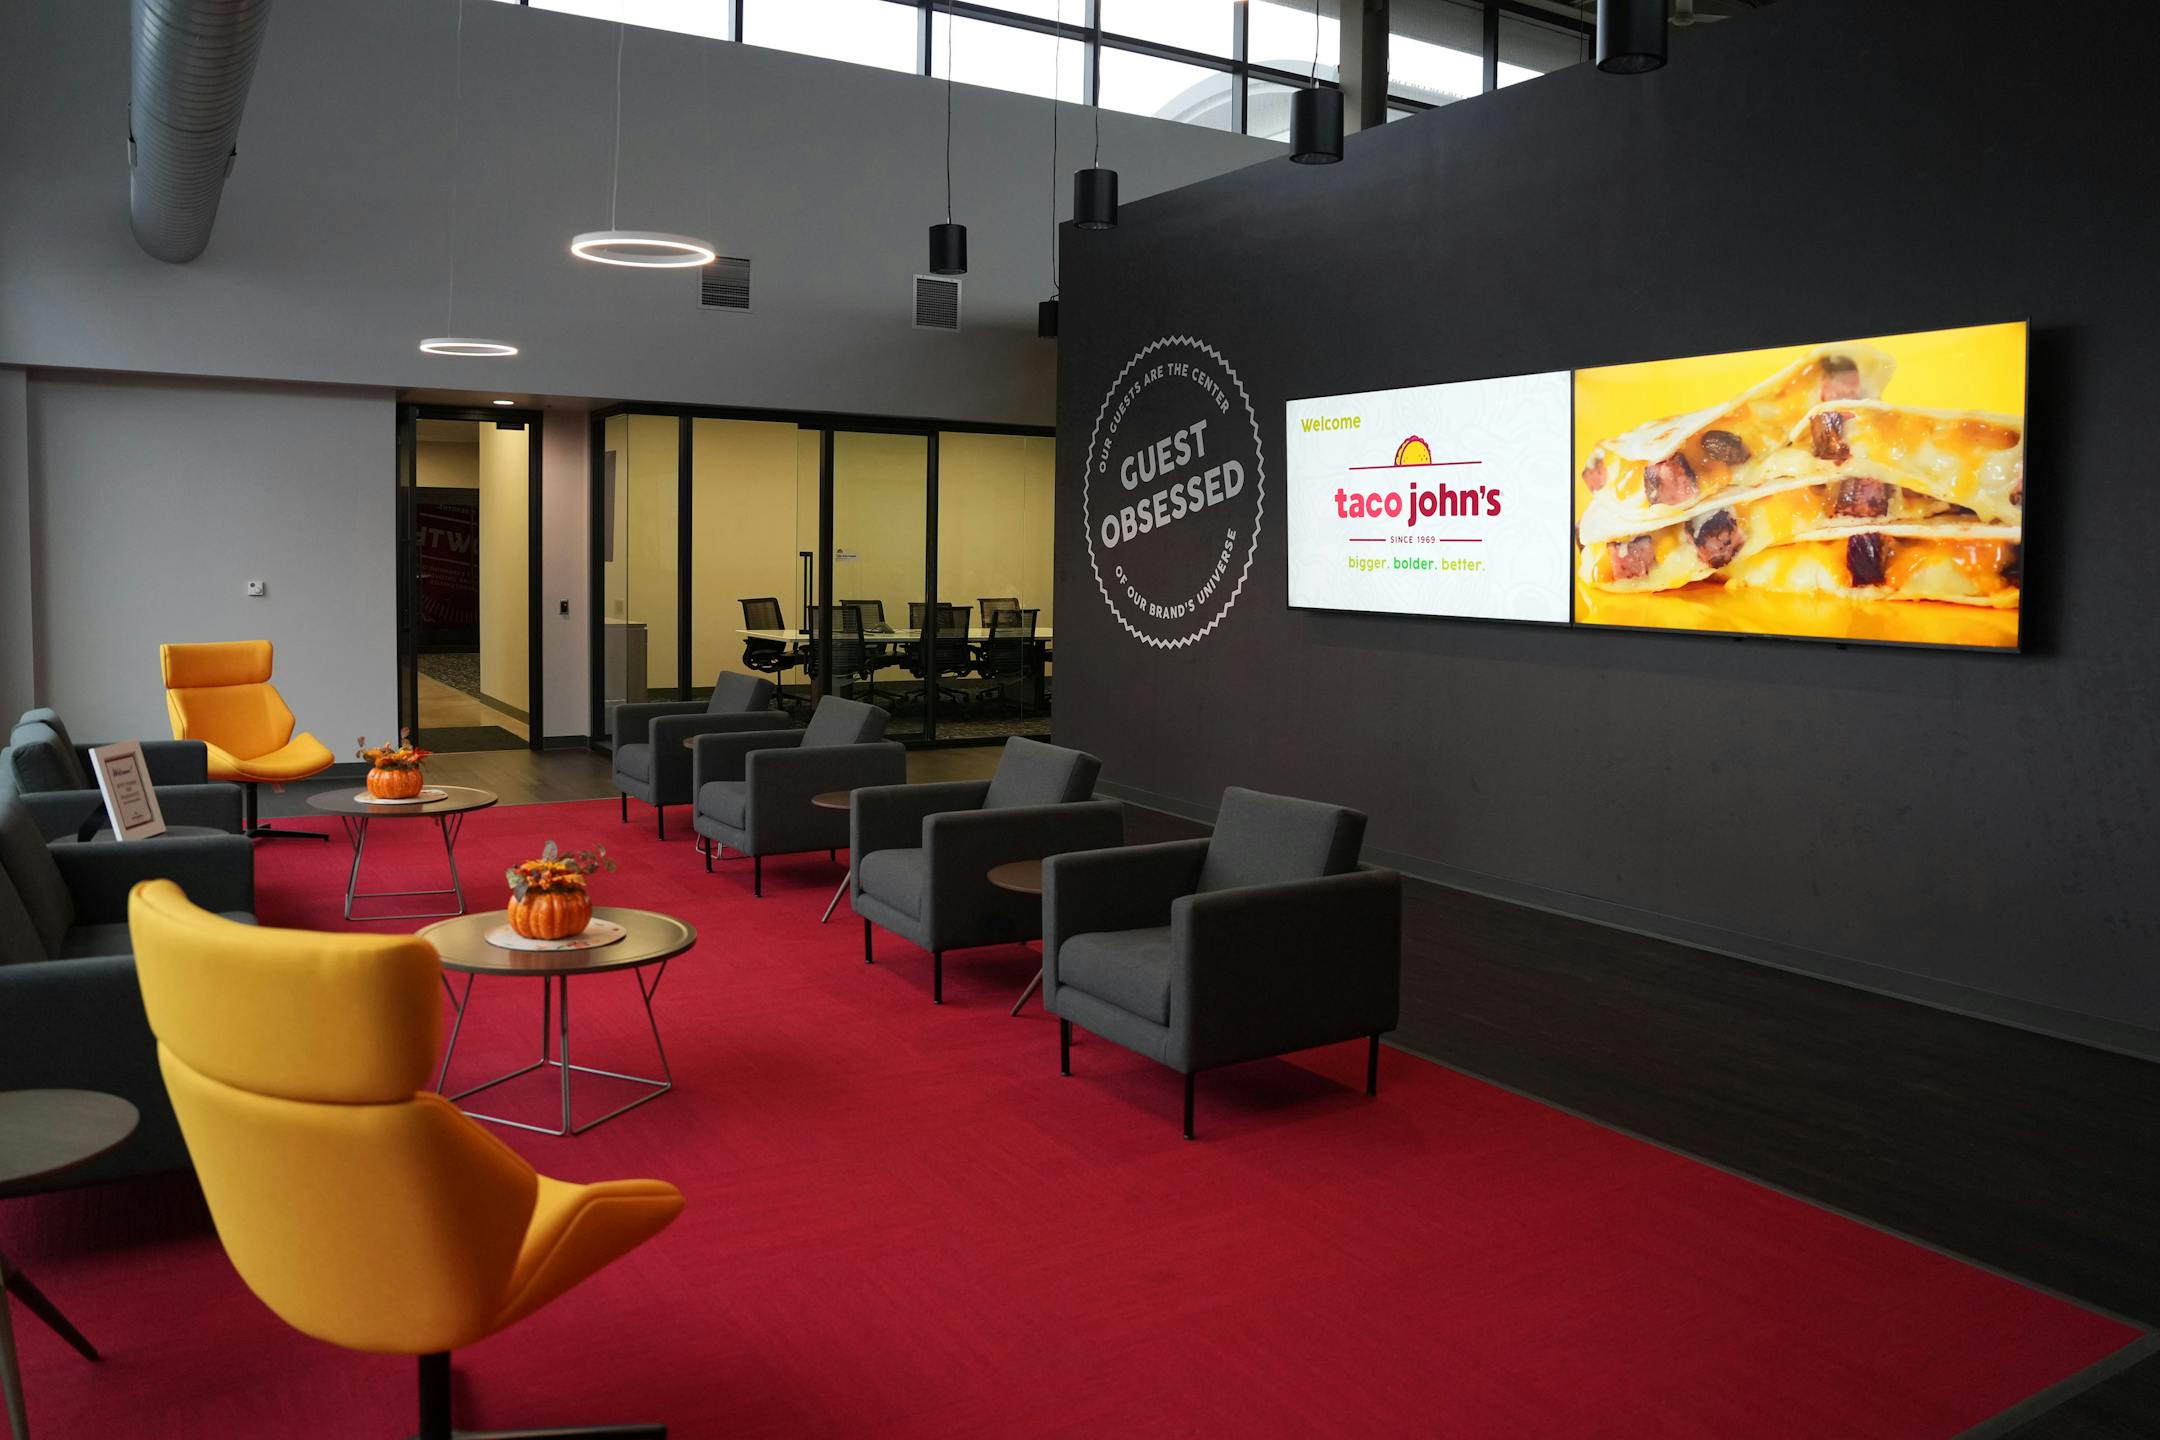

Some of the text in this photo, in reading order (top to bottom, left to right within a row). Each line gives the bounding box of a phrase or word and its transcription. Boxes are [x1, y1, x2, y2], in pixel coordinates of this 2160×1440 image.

[1100, 363, 1230, 474] OUR GUESTS ARE THE CENTER
[1301, 415, 1361, 432] Welcome
[1120, 419, 1208, 491] GUEST
[1101, 460, 1245, 548] OBSESSED
[1334, 482, 1502, 527] taco john's
[1348, 556, 1485, 572] bigger. bolder. better.
[1390, 535, 1436, 544] SINCE 1969
[1115, 528, 1237, 619] OF OUR BRAND'S UNIVERSE
